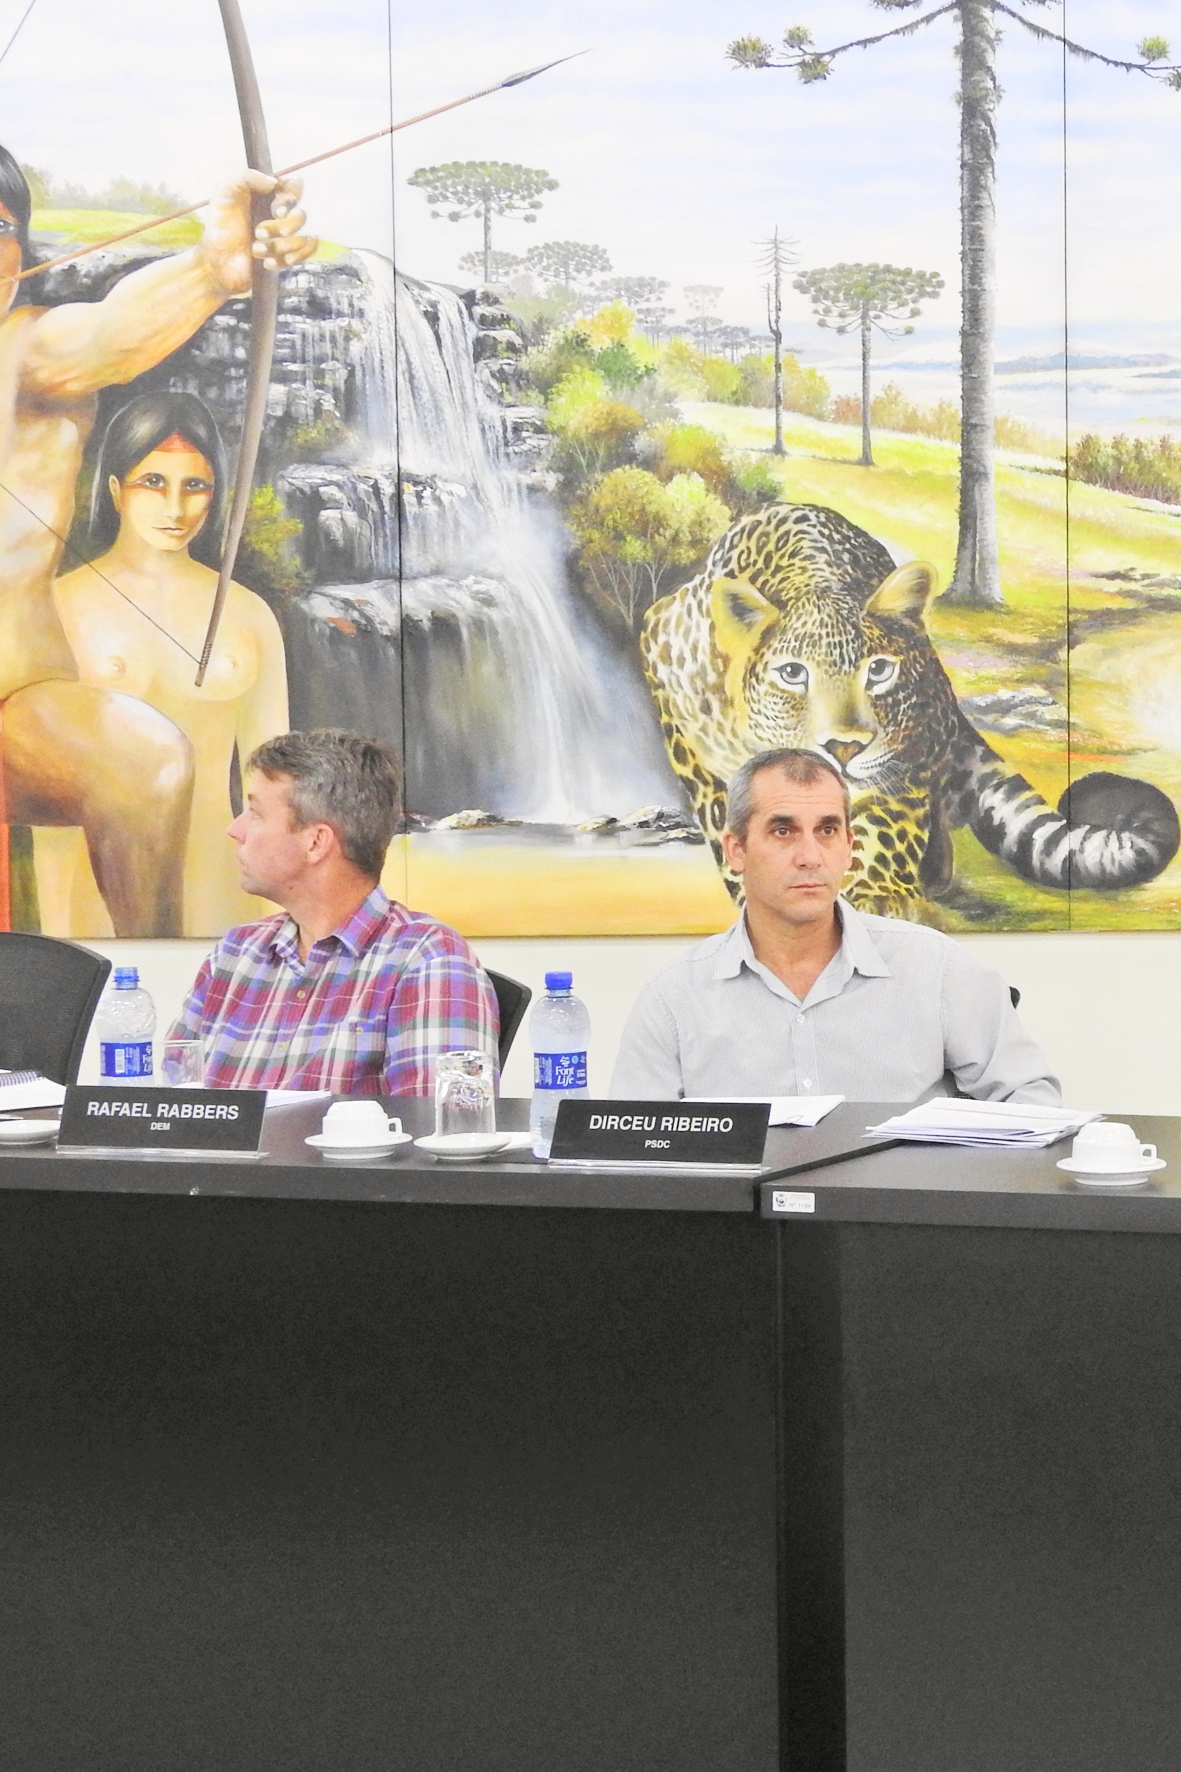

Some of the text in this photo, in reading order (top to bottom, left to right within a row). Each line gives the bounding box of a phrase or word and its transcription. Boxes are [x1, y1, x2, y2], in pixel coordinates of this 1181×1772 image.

[555, 1065, 575, 1076] Font
[556, 1075, 574, 1087] Life
[86, 1101, 240, 1120] RAFAEL RABBERS
[150, 1121, 171, 1131] DEM
[589, 1114, 734, 1133] DIRCEU RIBEIRO
[644, 1139, 671, 1149] PSDC
